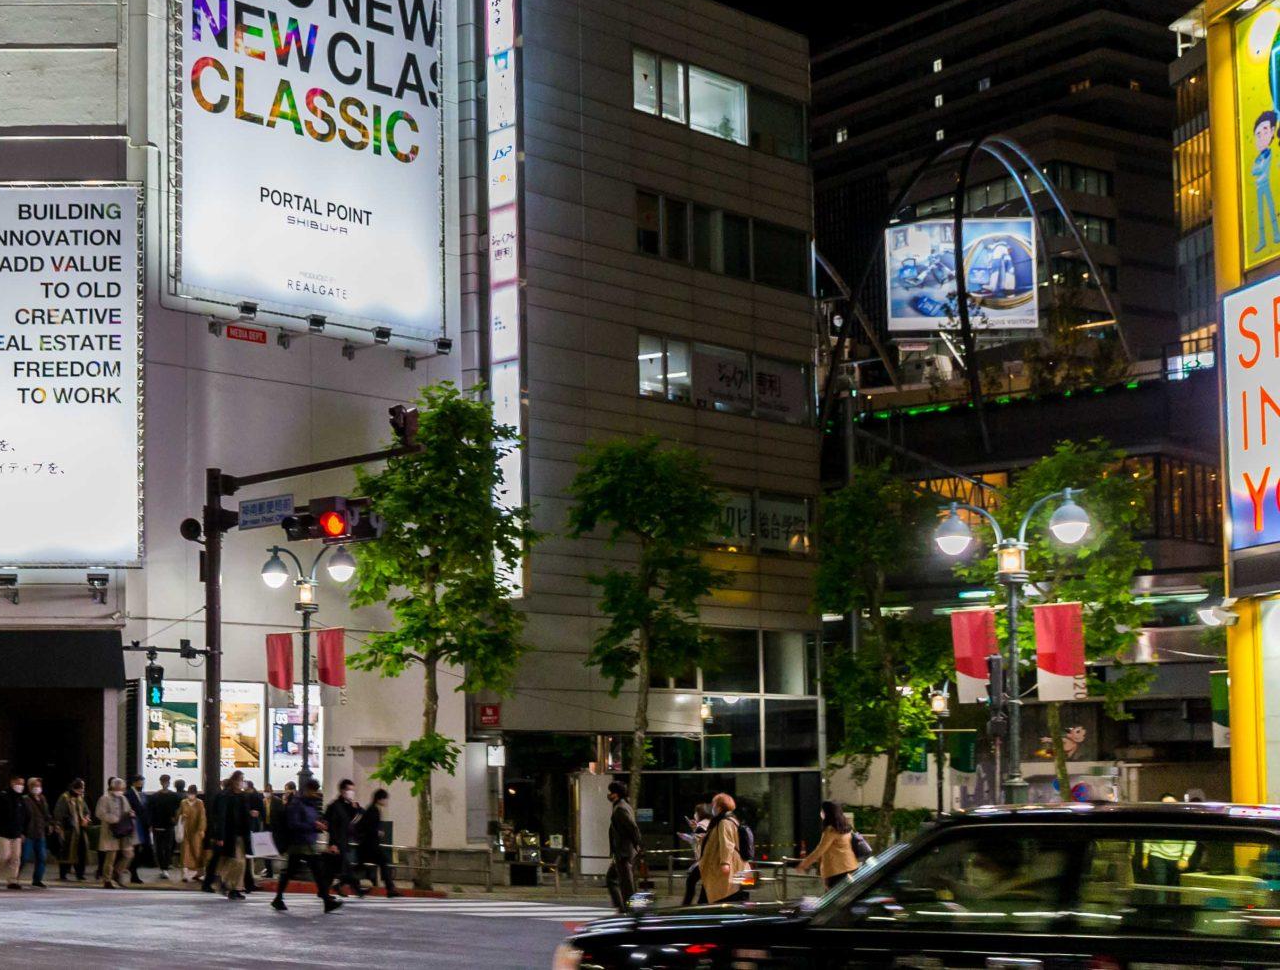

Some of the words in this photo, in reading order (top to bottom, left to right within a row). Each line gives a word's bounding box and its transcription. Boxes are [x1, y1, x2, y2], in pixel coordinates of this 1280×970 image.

[190, 56, 419, 164] CLASSIC
[17, 203, 122, 221] BUILDING
[260, 186, 322, 216] PORTAL
[327, 202, 372, 226] POINT
[286, 216, 348, 234] SHIBUYA
[51, 255, 122, 273] VALUE
[40, 282, 70, 299] TO
[76, 282, 122, 299] OLD
[287, 280, 348, 300] REALGATE
[14, 308, 122, 326] CREATIVE
[38, 334, 122, 352] ESTATE
[13, 361, 122, 379] FREEDOM
[17, 387, 47, 404] TO
[52, 387, 122, 404] WORK
